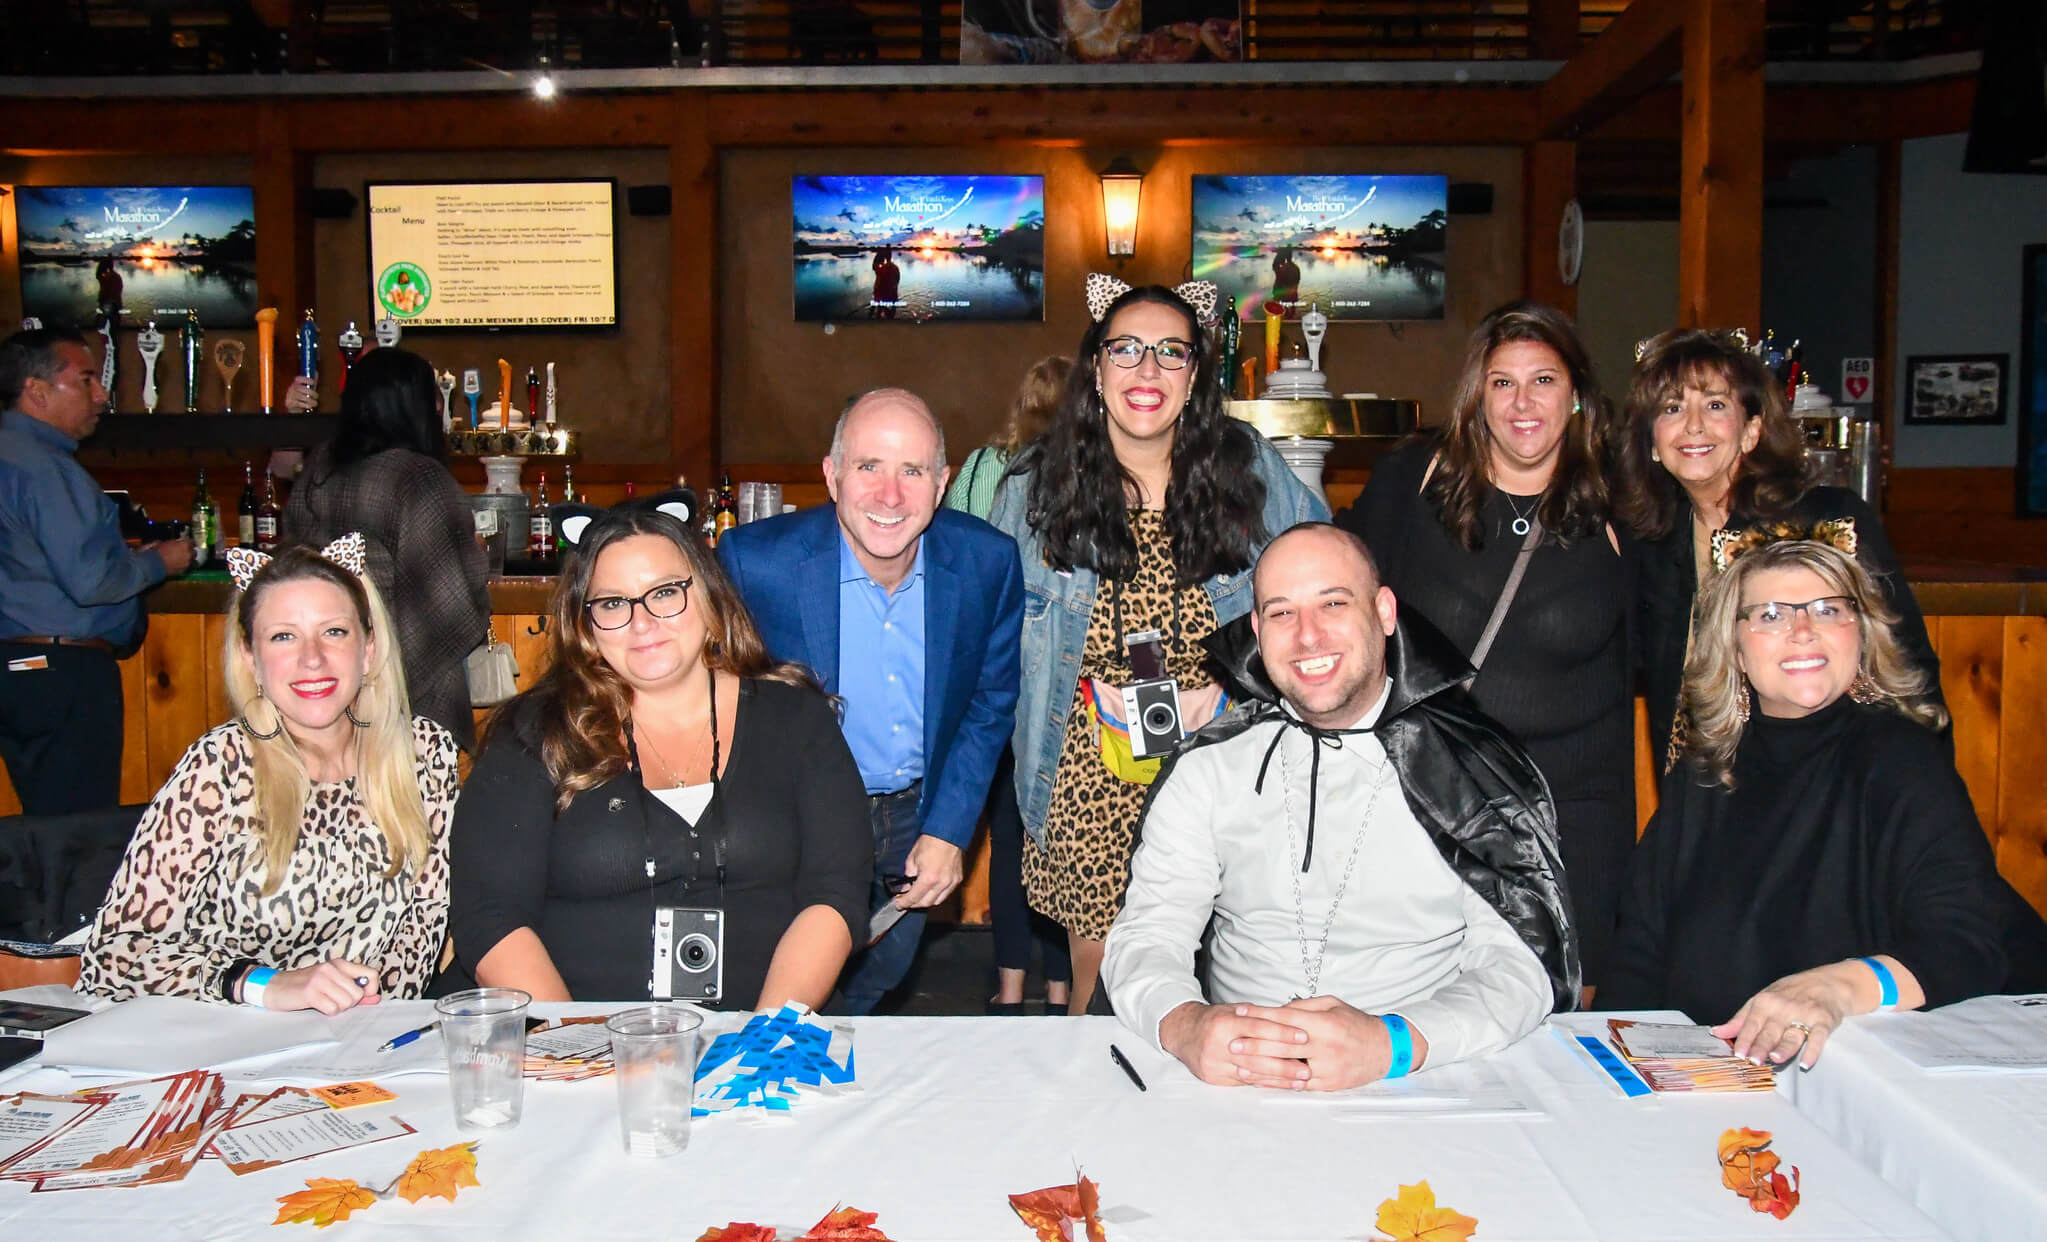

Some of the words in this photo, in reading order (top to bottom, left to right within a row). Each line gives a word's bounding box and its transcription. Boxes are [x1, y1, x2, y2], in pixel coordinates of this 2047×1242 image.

[884, 196, 943, 212] Marathon
[1286, 195, 1345, 212] Marathon
[103, 206, 160, 223] Marathon
[402, 217, 425, 225] Menu
[1846, 360, 1870, 373] AED
